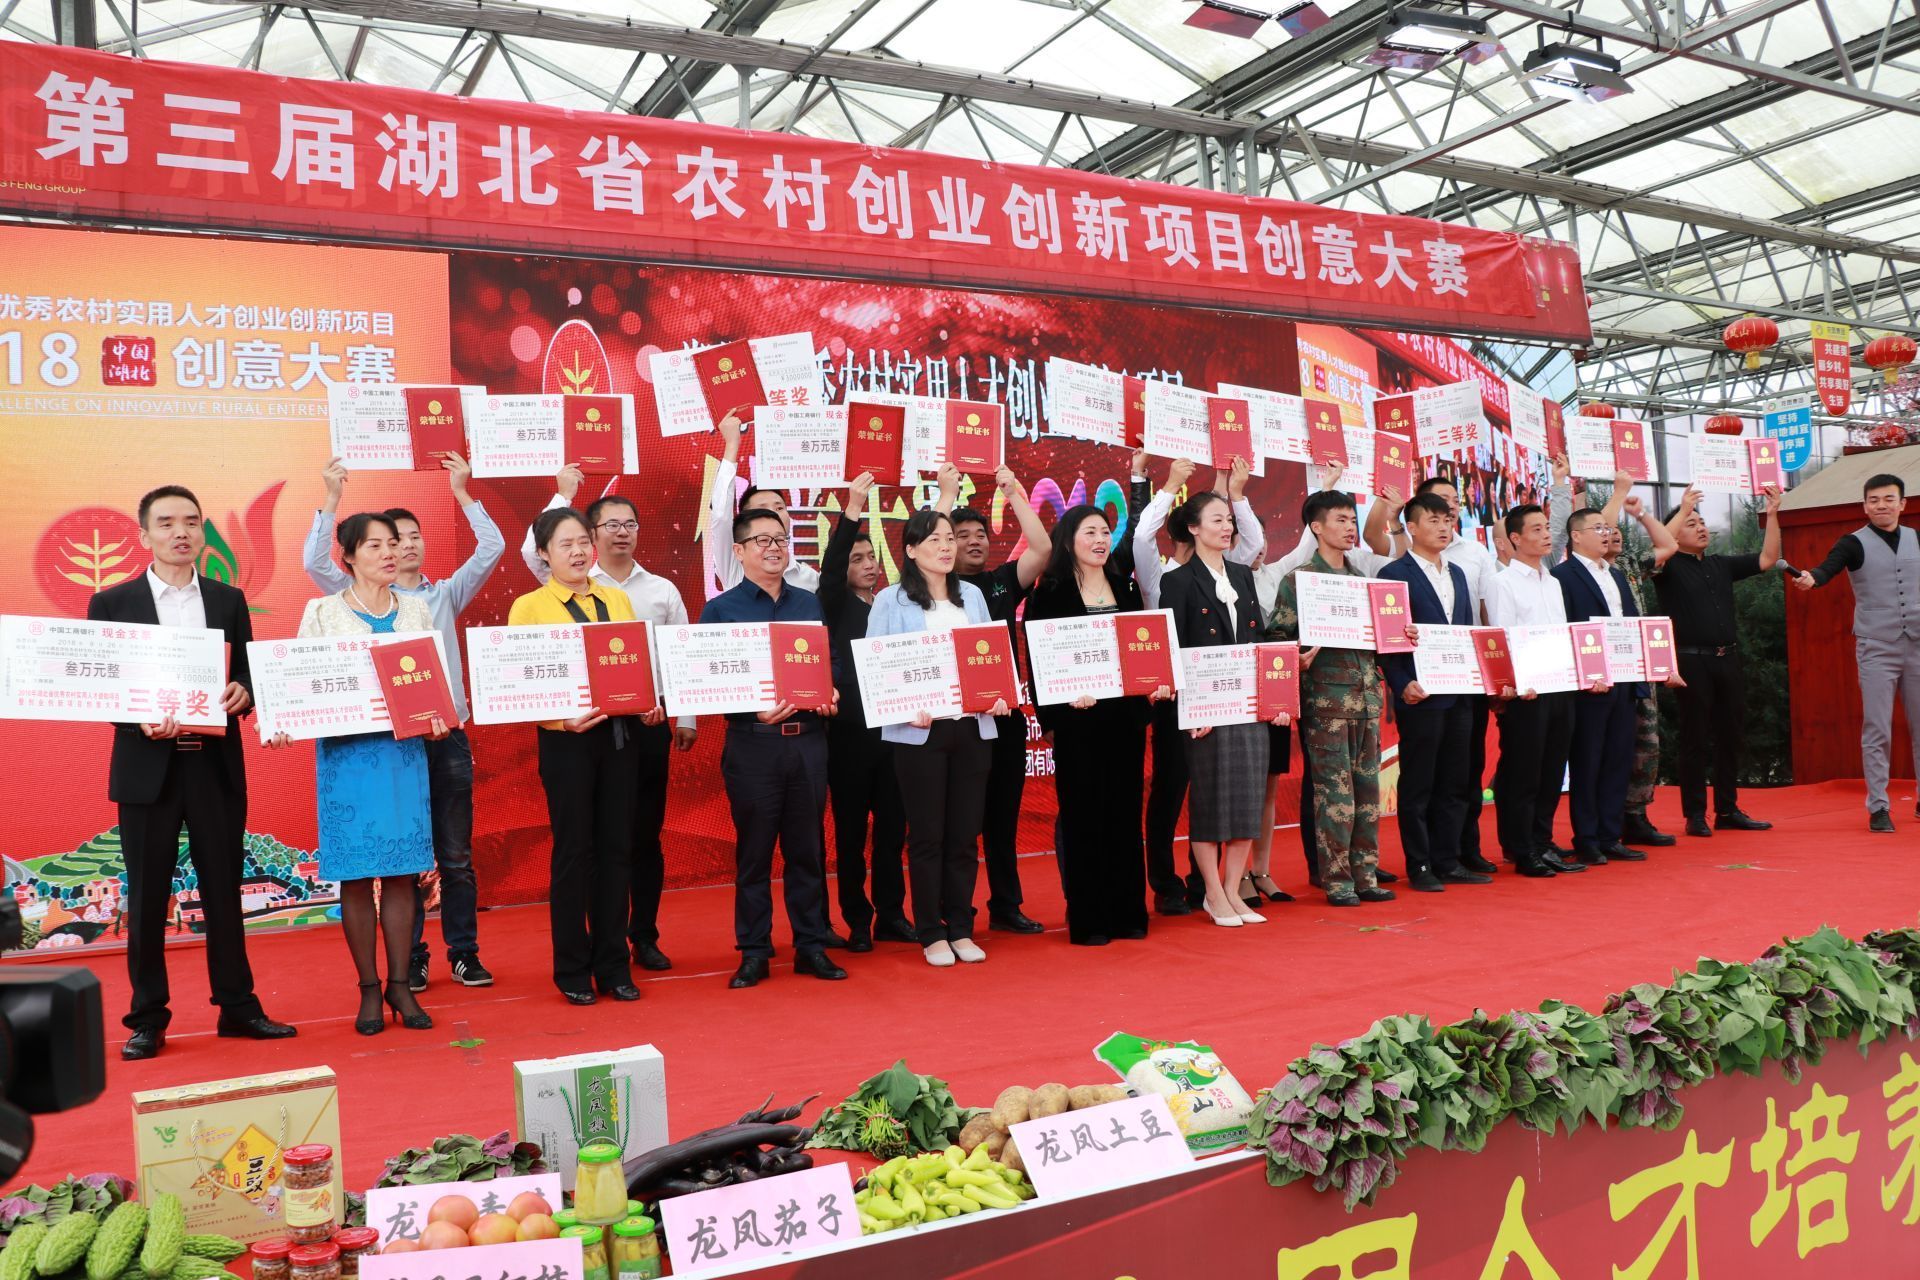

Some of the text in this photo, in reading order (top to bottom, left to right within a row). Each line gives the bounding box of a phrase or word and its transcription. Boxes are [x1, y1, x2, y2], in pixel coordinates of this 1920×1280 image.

[35, 70, 1469, 298] 第三届湖北省农村创业创新项目创意大赛
[1824, 342, 1848, 356] 共建美
[0, 331, 80, 388] 18
[171, 338, 396, 392] 创意大赛
[711, 367, 748, 386] 荣誉证书
[1819, 376, 1849, 390] 共享美好
[1085, 396, 1113, 413] 叁万元整
[1828, 394, 1844, 406] 生活
[76, 399, 101, 412] ON
[107, 399, 207, 414] INNOVATIVE
[212, 401, 263, 416] RURAL
[575, 421, 612, 432] 荣誉证书
[956, 425, 990, 436] 荣誉证书
[1218, 422, 1244, 432] 荣誉证书
[516, 428, 558, 441] 叁万元整
[857, 430, 893, 443] 荣誉证书
[1437, 422, 1478, 447] 三等奖
[800, 439, 841, 453] 叁万元整
[1330, 604, 1358, 617] 叁万元整
[1379, 606, 1404, 615] 荣誉证书
[49, 626, 95, 637] 中国工商银行
[507, 632, 545, 641] 中国工商银行
[291, 645, 331, 655] 中国工商银行
[1128, 642, 1161, 652] 荣誉证书
[599, 653, 638, 666] 荣誉证书
[784, 652, 820, 664] 荣誉证书
[967, 654, 1002, 667] 荣誉证书
[1073, 649, 1110, 665] 叁万元整
[65, 660, 120, 679] 叁万元整
[523, 663, 569, 680] 叁万元整
[709, 660, 751, 675] 叁万元整
[903, 665, 942, 684] 叁万元整
[392, 669, 432, 687] 荣誉证书
[1265, 670, 1292, 680] 荣誉证书
[311, 676, 360, 694] 叁万元整
[1212, 678, 1243, 692] 叁万元整
[127, 687, 210, 717] 三等奖
[1156, 1058, 1214, 1113] 龙凤山
[1034, 1108, 1174, 1168] 龙凤土豆
[687, 1192, 846, 1264] 龙凤茄子
